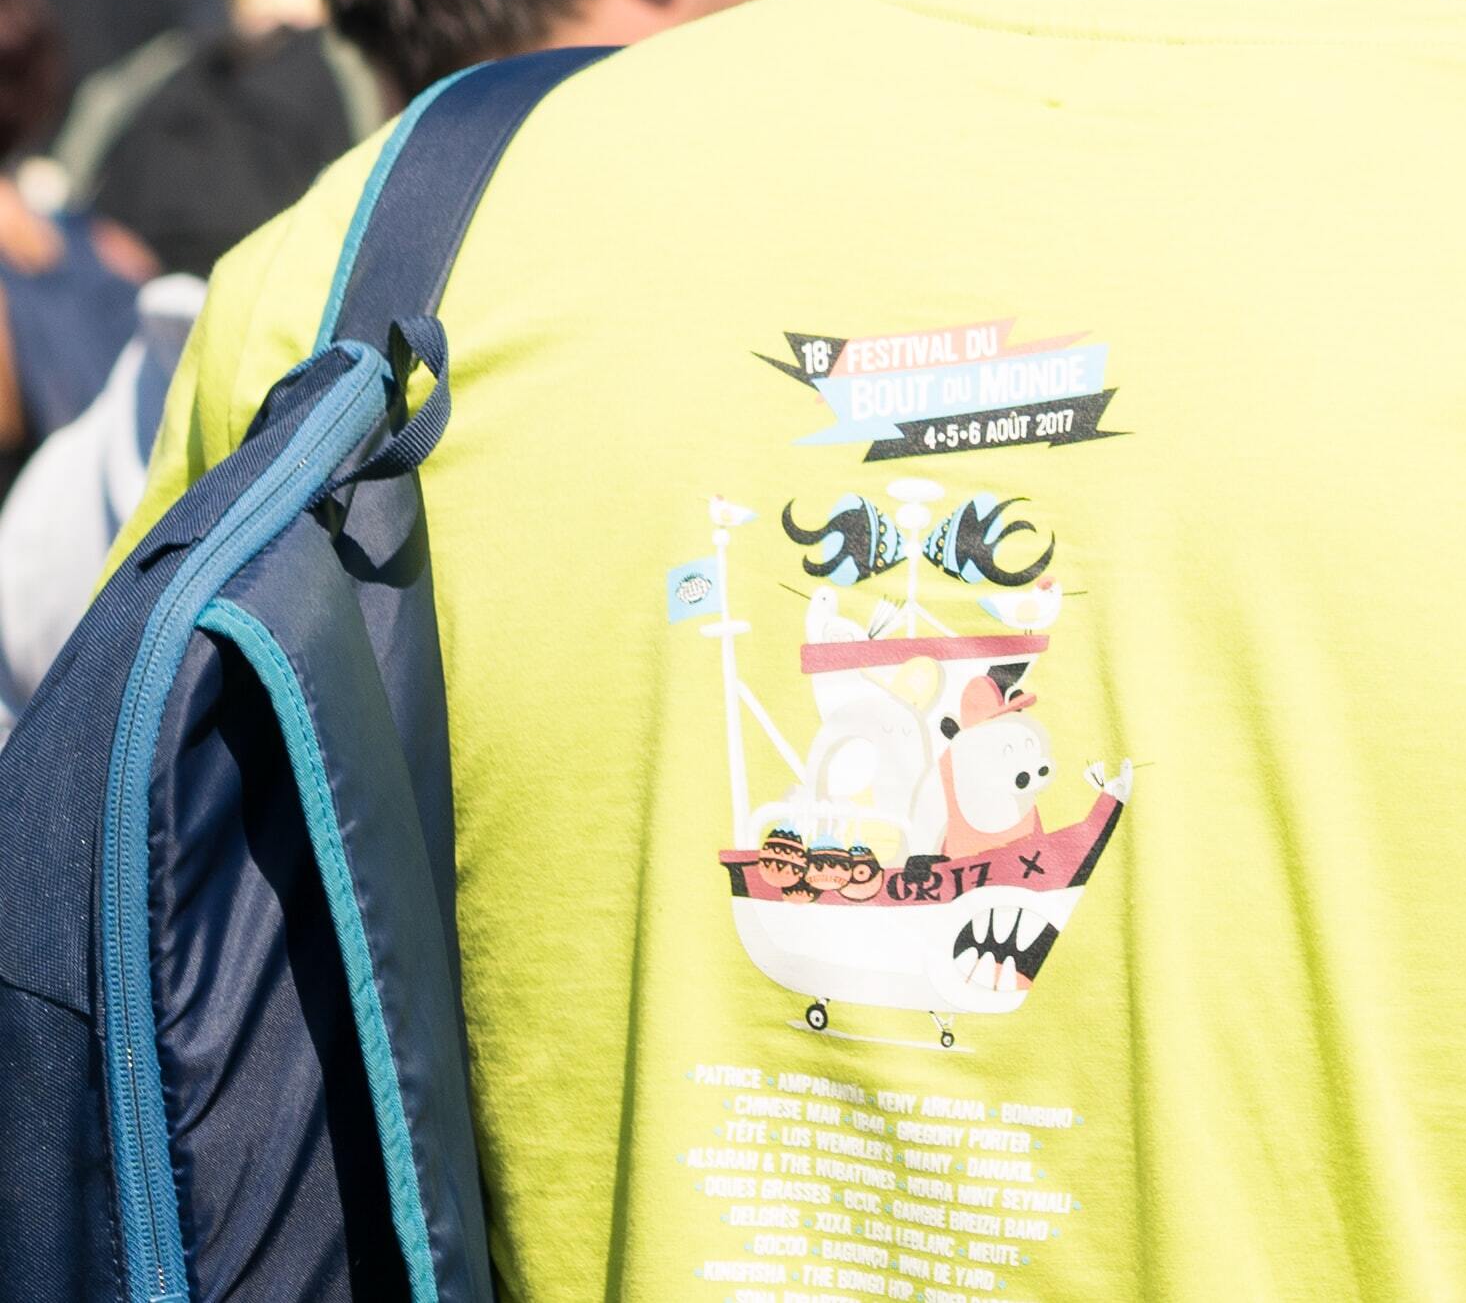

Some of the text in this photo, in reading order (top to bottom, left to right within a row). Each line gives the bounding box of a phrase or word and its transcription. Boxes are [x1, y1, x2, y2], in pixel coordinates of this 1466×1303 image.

[846, 330, 958, 374] FESTIVAL
[965, 325, 998, 357] DU
[851, 353, 1088, 421] BOUT DU MONDE
[985, 409, 1029, 444] AOÛT
[1034, 408, 1074, 437] 2017
[781, 1126, 811, 1148] LOS
[780, 1152, 811, 1175] THE
[802, 1264, 834, 1288] THE
[955, 1266, 995, 1291] YARD
